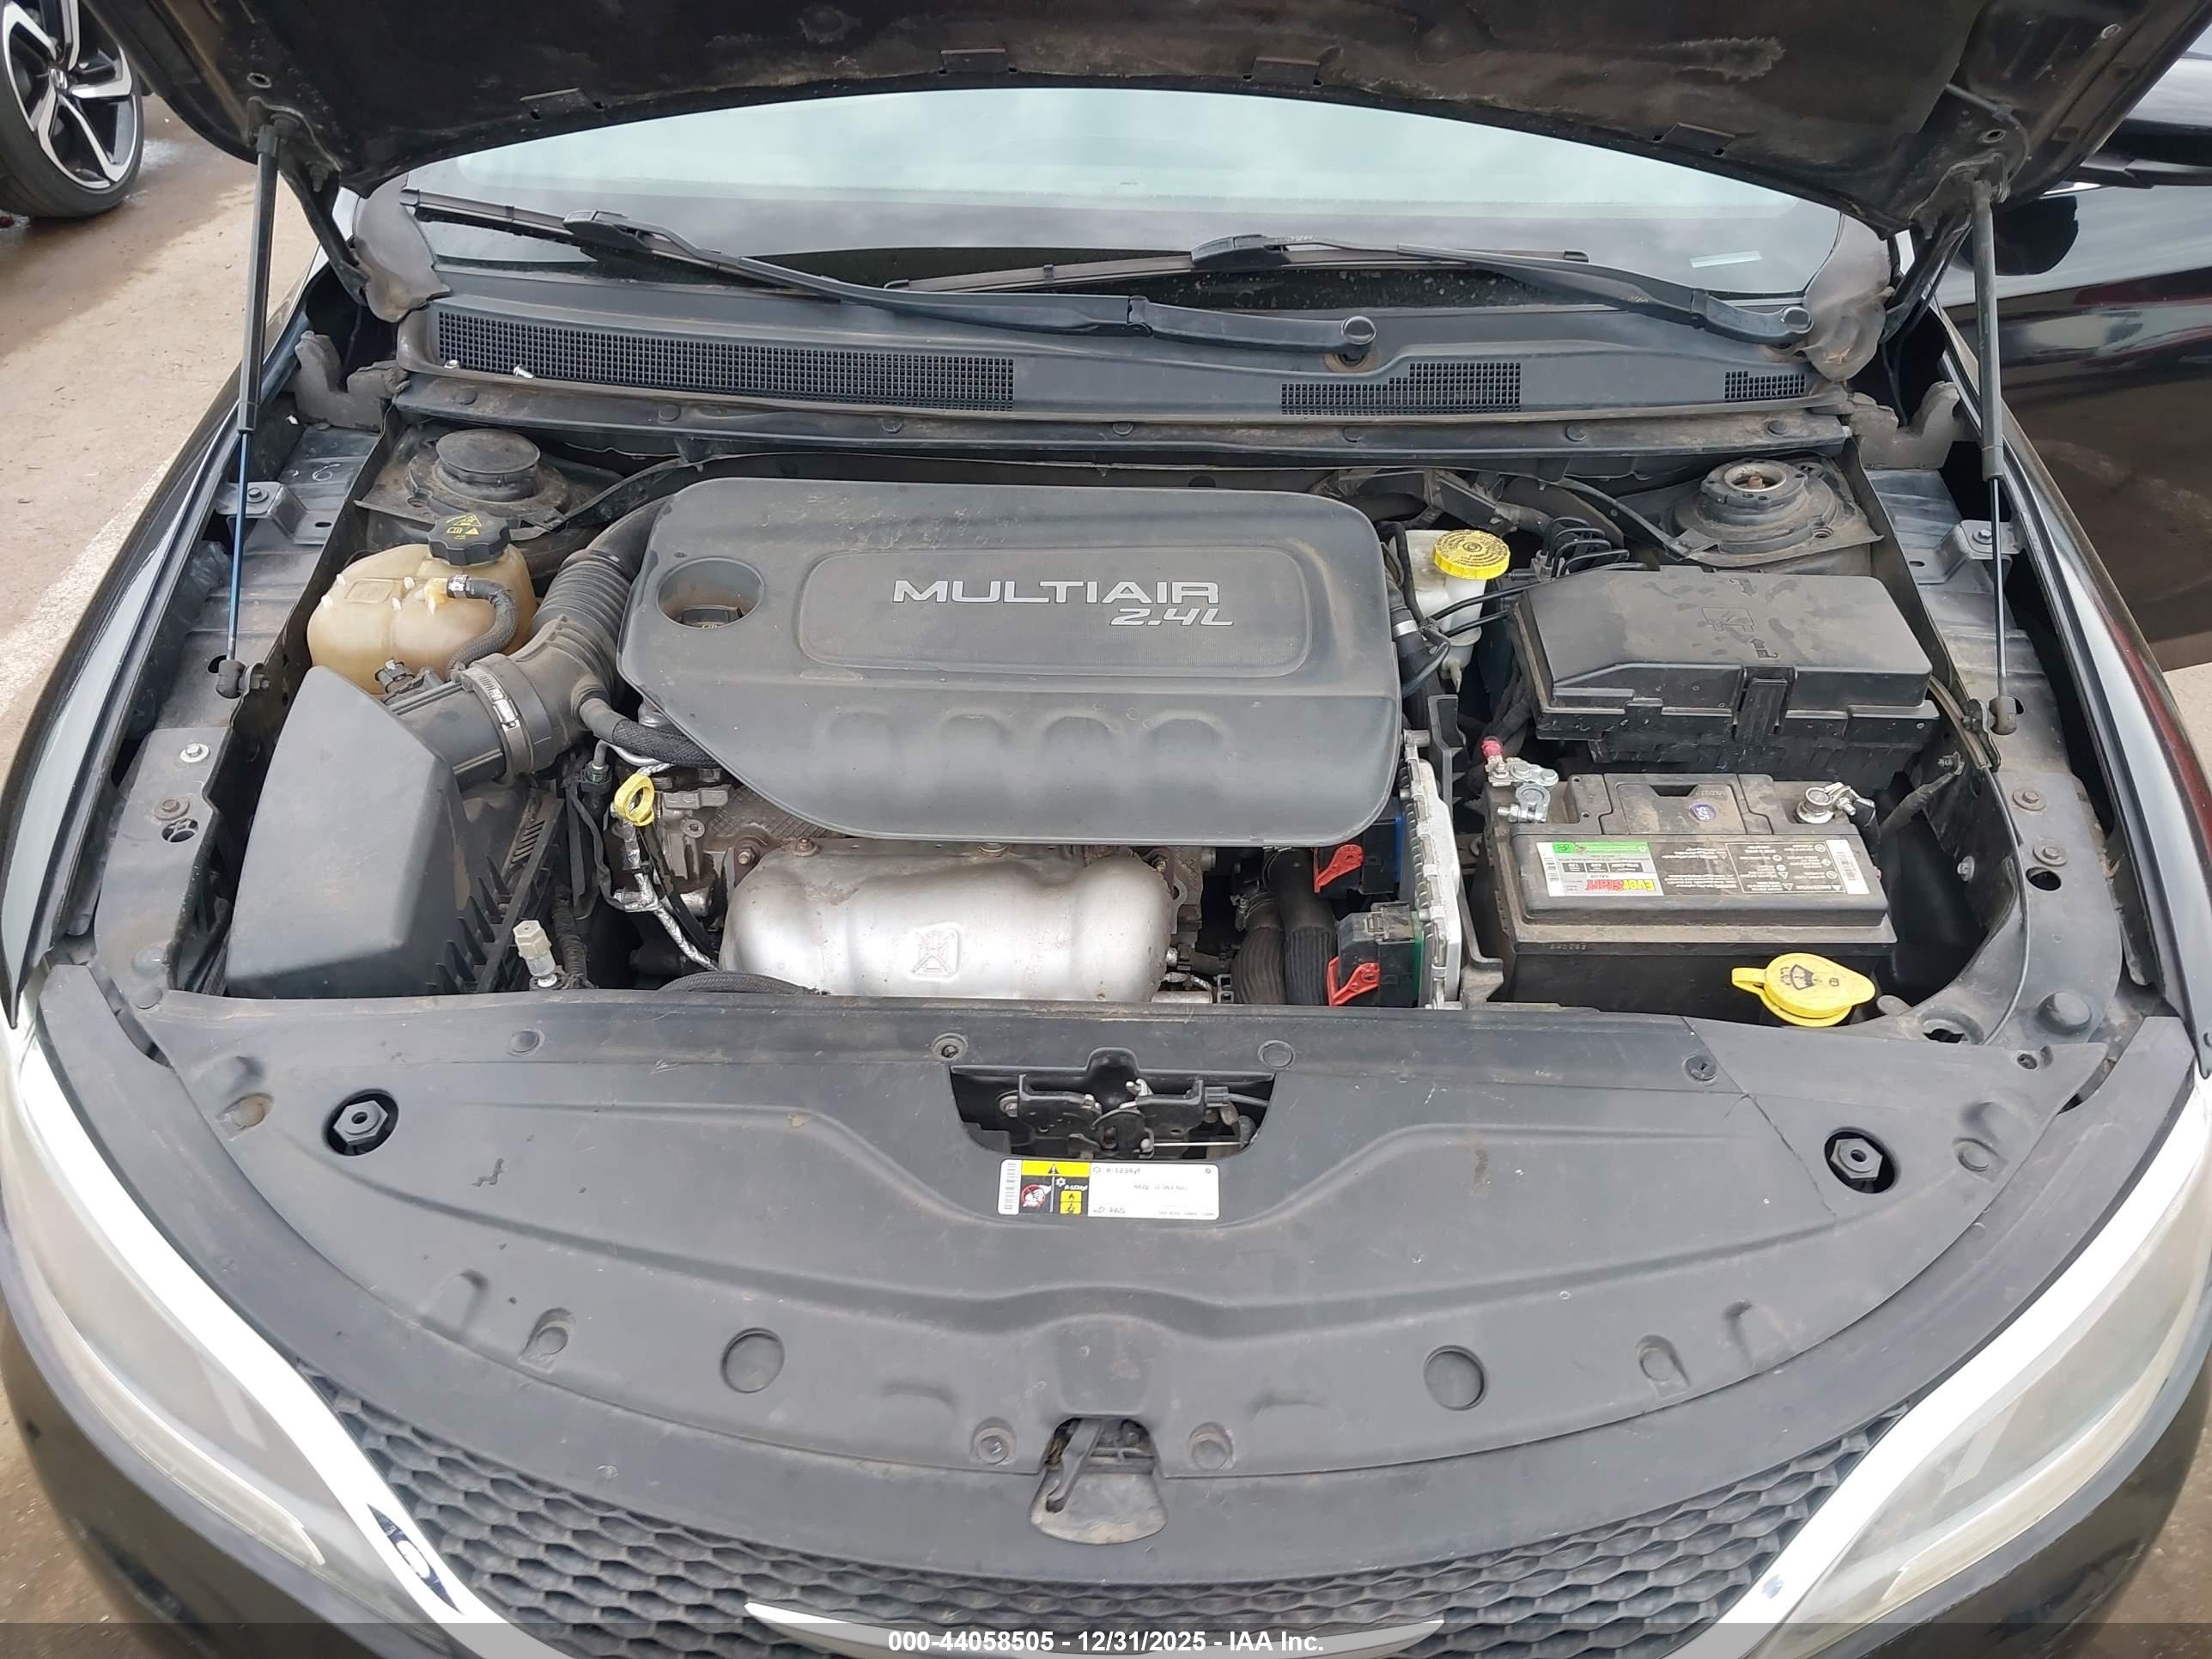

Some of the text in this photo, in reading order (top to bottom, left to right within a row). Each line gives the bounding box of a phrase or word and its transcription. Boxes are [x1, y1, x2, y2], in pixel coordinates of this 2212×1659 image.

[893, 580, 1220, 605] MULTIAIR
[1109, 608, 1234, 626] 2.4L
[1586, 878, 1656, 892] EverStart
